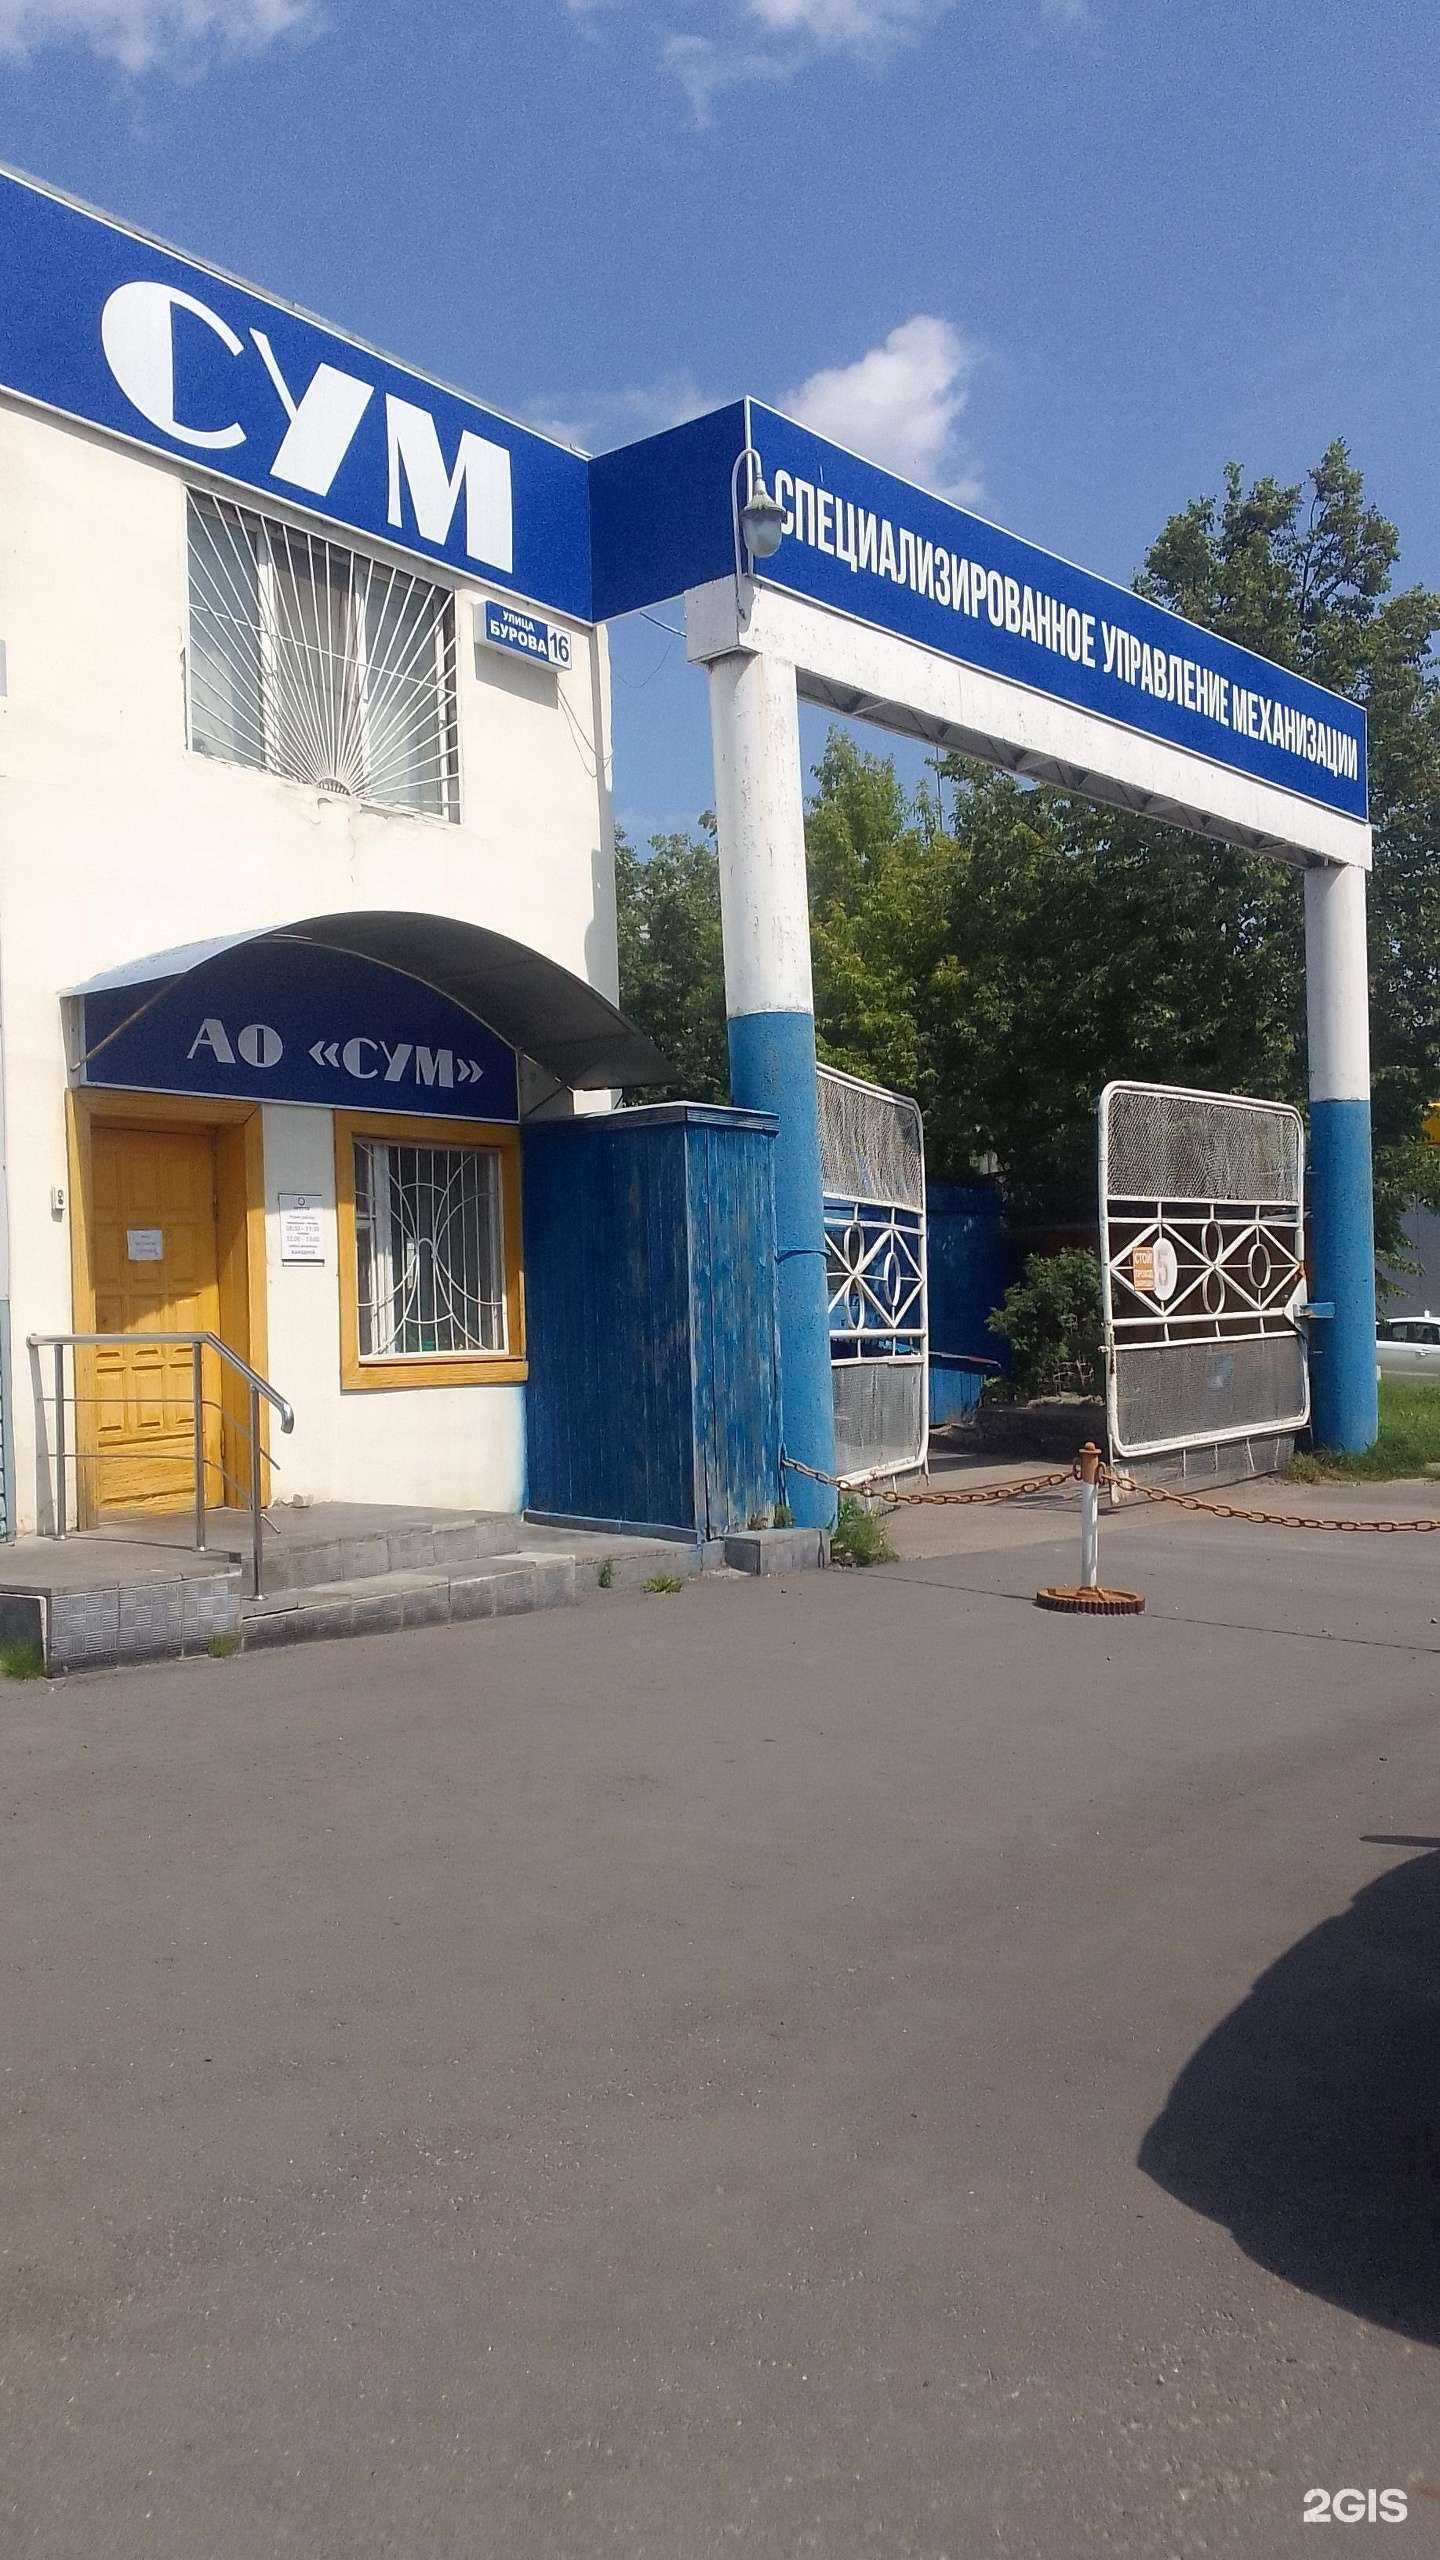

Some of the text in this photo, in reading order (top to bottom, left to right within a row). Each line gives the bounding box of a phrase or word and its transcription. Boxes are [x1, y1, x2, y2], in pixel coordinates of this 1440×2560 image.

[101, 281, 513, 574] СУМ
[490, 619, 569, 662] БУРОВА 16
[502, 609, 535, 632] УЛИЦА
[774, 469, 1358, 781] СПЕЦИАЛИЗИРОВАННОЕ УПРАВЛЕНИЕ МЕХАНИЗАЦИИ
[186, 1018, 484, 1088] АО «СУМ»
